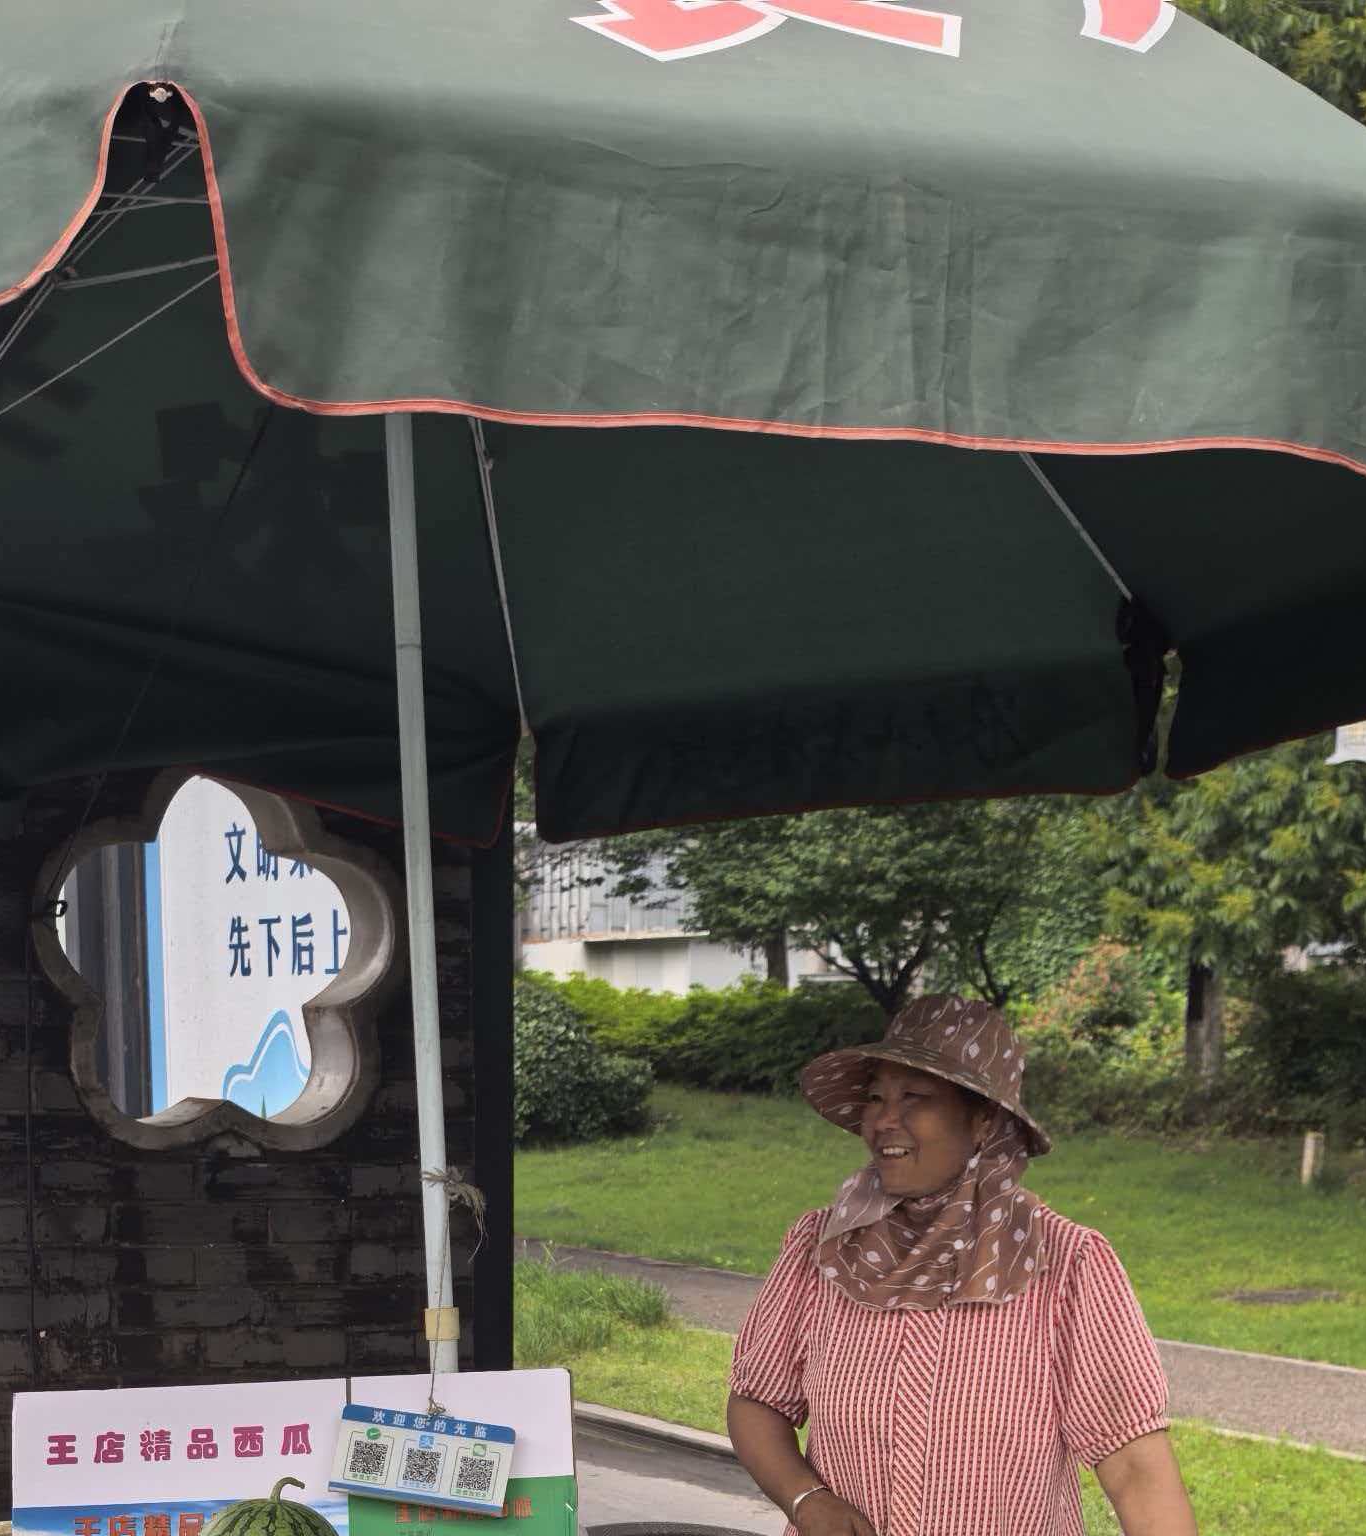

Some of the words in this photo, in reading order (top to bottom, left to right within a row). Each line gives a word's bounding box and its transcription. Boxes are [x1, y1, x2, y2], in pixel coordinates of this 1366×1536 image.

[229, 909, 348, 977] 先下后上
[371, 1408, 488, 1438] 欢迎您的光临
[46, 1424, 312, 1466] 王店精品西瓜
